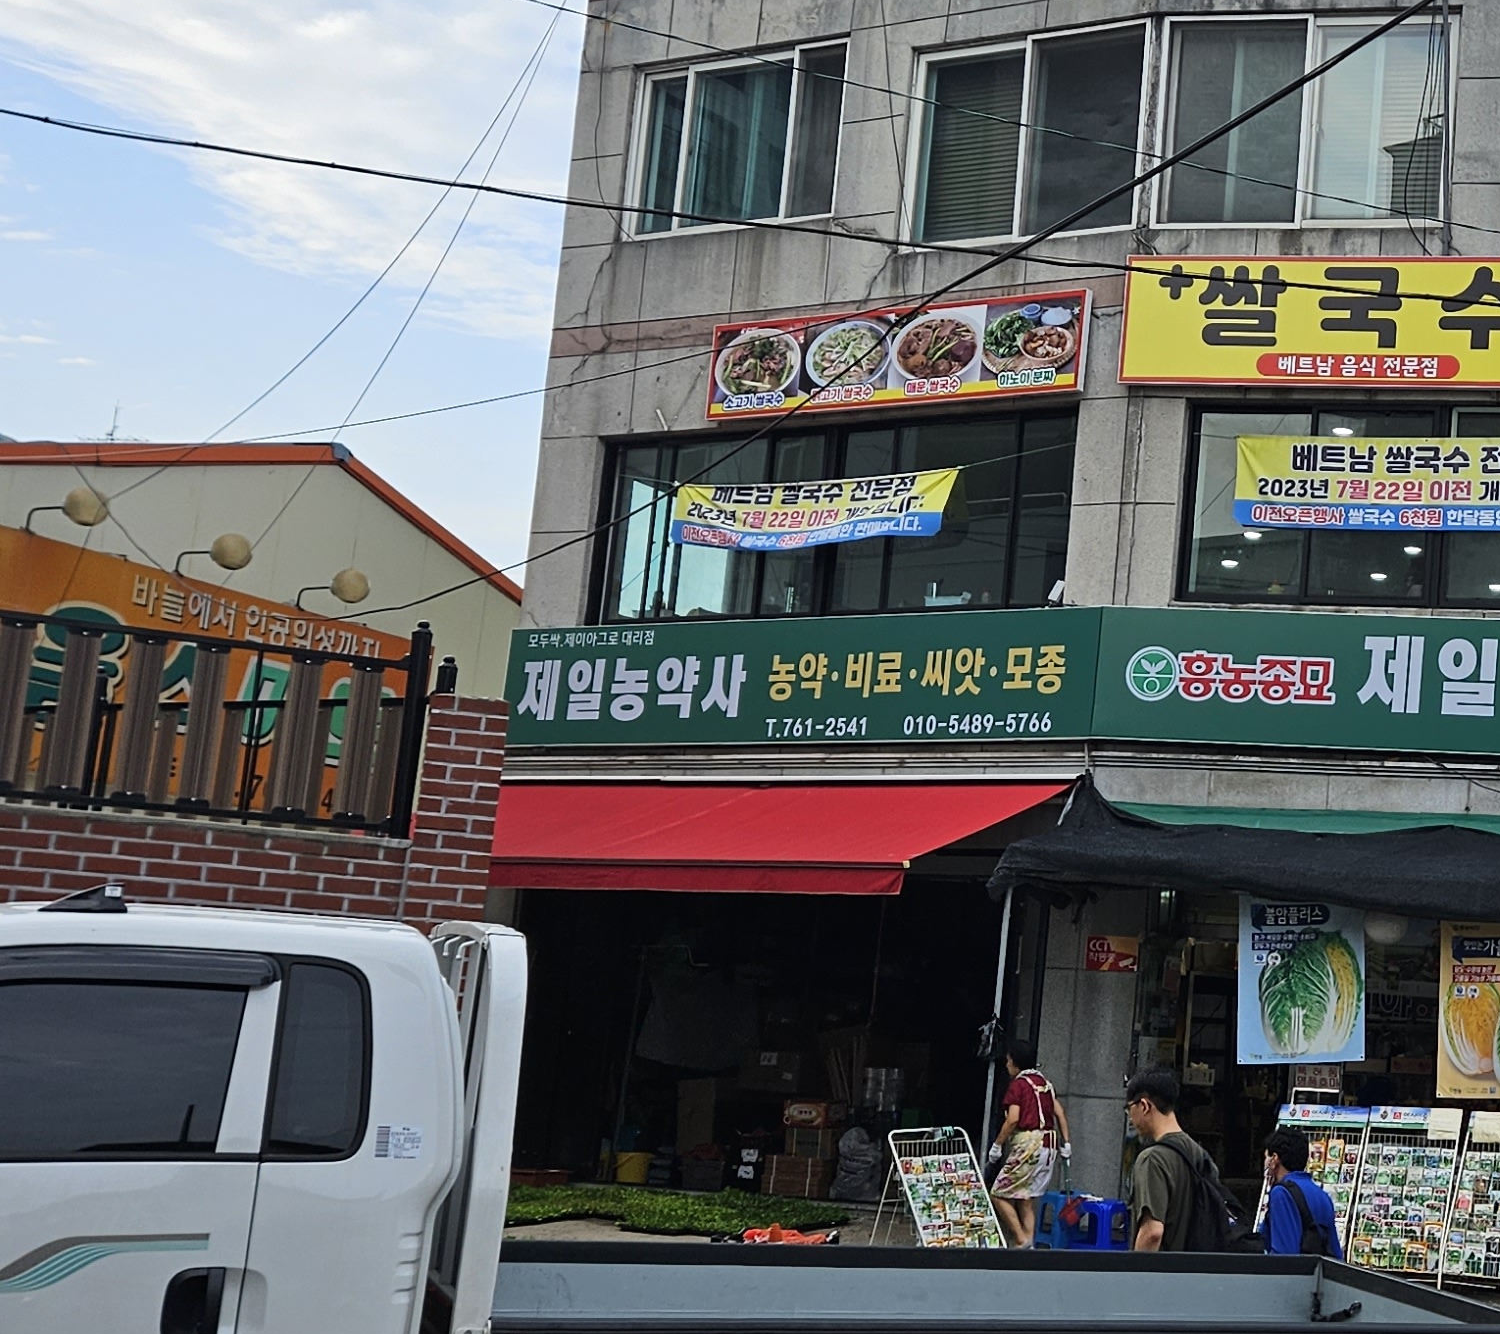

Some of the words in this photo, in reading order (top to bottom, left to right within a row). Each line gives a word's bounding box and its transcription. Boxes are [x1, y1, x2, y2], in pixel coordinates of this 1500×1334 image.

[1278, 355, 1334, 376] 베트남
[1339, 356, 1377, 377] 음식
[1382, 357, 1439, 378] 전문점
[842, 386, 873, 402] 쌀국수
[927, 377, 960, 394] 쌀국수
[723, 394, 753, 410] 소고기
[754, 392, 785, 408] 쌀국수
[1291, 444, 1377, 473] 베트남
[1384, 445, 1470, 474] 쌀국수
[851, 475, 917, 502] 전문점
[1258, 478, 1330, 499] 2023년
[1336, 480, 1370, 499] 7월
[1374, 480, 1423, 501] 22일
[1429, 480, 1473, 501] 이전
[741, 511, 766, 528] 7월
[770, 510, 805, 529] 22일
[807, 508, 840, 528] 이전
[1251, 504, 1346, 526] 이전오픈행사
[1347, 507, 1395, 526] 쌀국수
[1398, 508, 1443, 527] 6천원
[131, 575, 238, 637] 바늘에서
[621, 630, 655, 646] 대리점
[517, 654, 747, 721] 제일농약사
[1178, 650, 1335, 704] 흥농종묘
[766, 717, 867, 738] T.761-2541
[903, 712, 1052, 736] 010-5489-5766
[1089, 939, 1115, 952] CCTV
